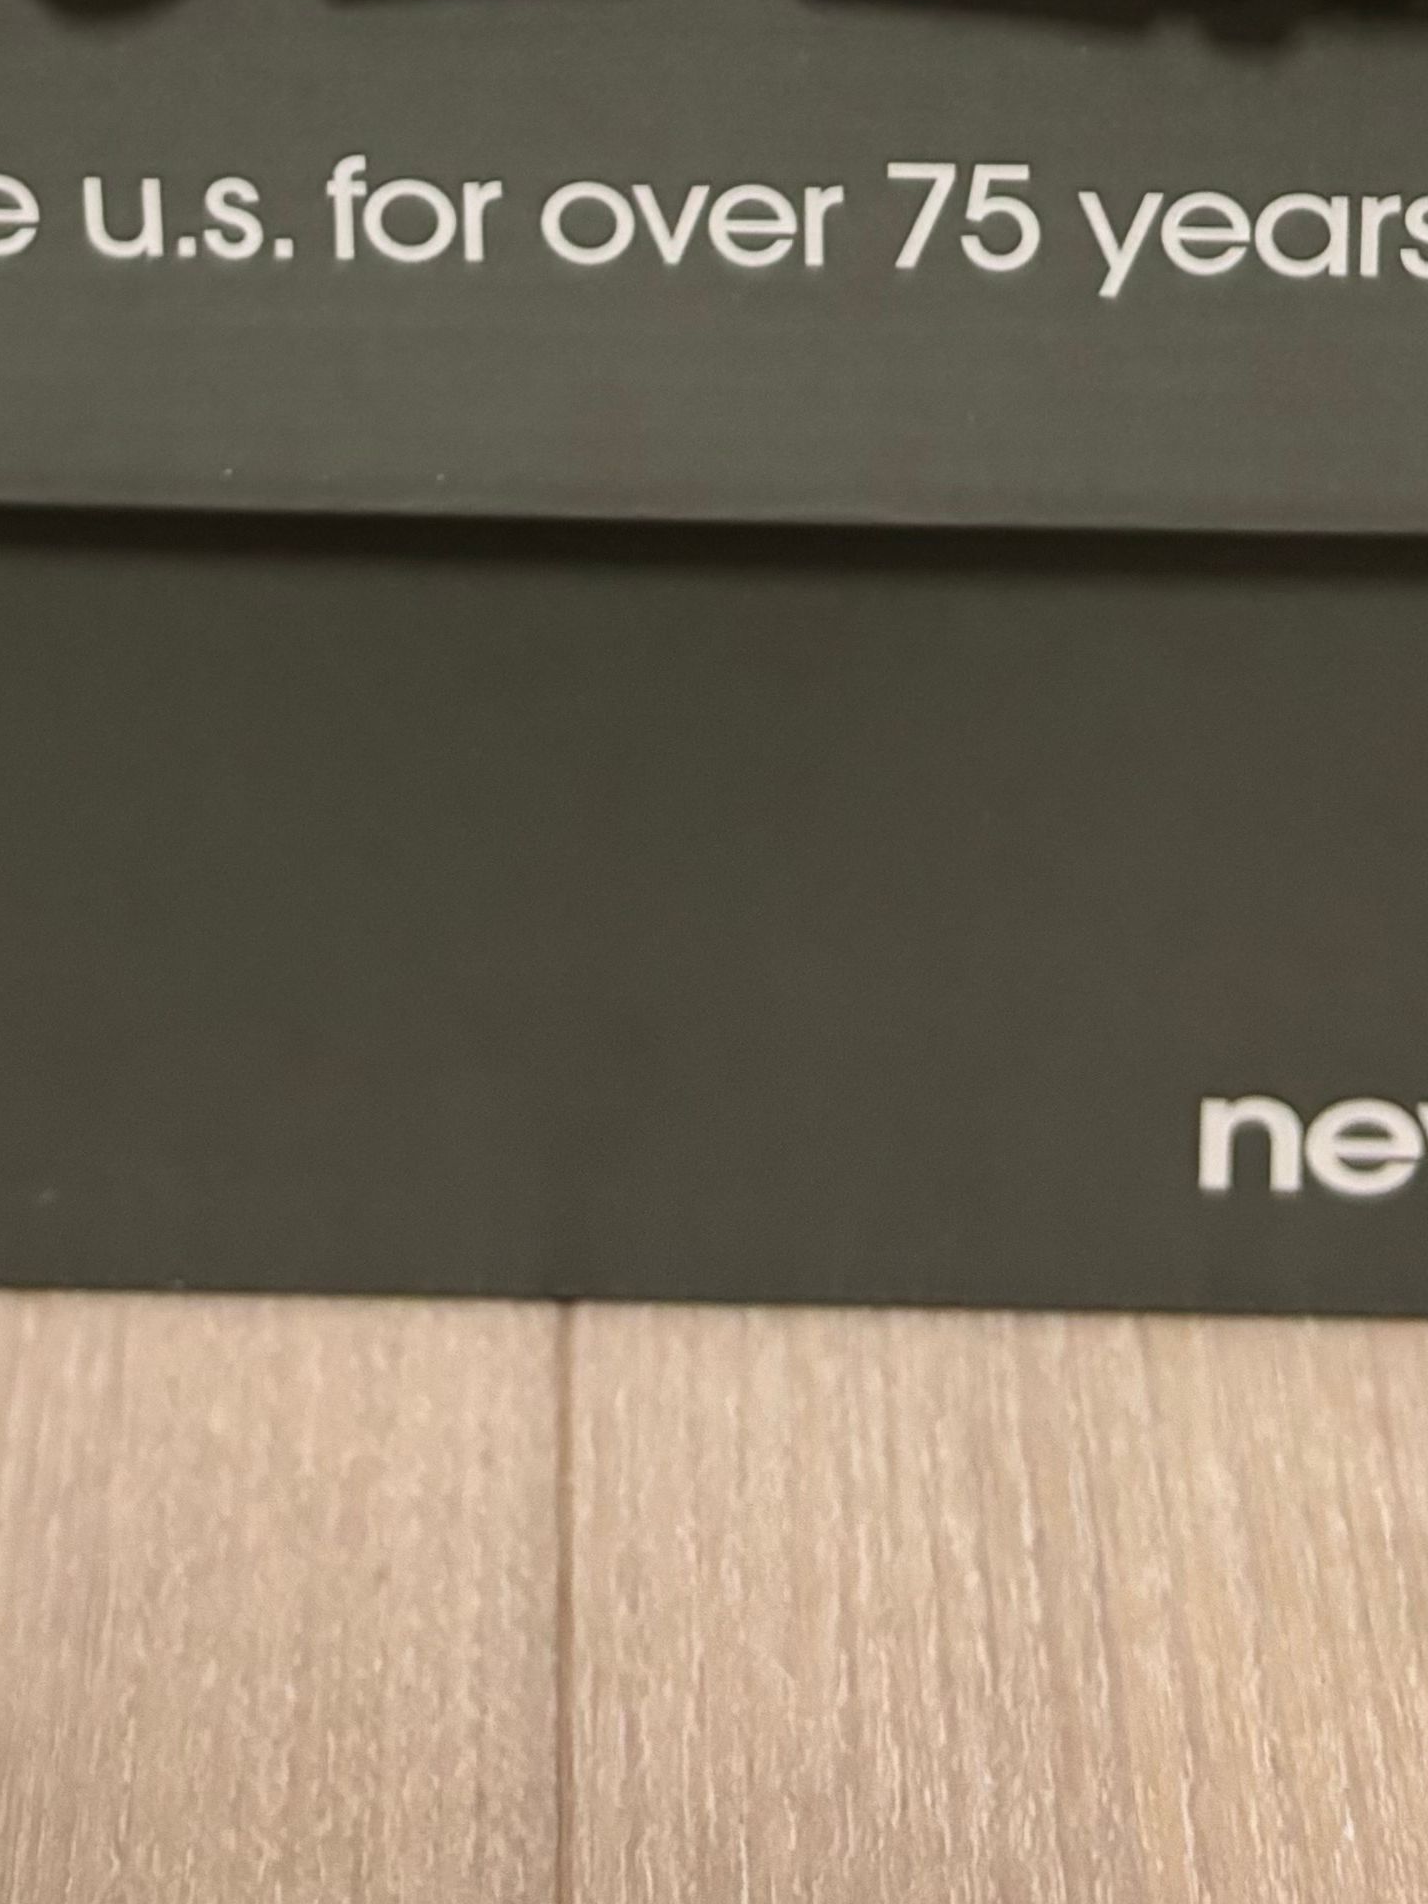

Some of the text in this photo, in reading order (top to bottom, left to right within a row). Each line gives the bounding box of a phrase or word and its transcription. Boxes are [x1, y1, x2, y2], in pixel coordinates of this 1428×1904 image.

[82, 176, 295, 262] u.s.
[325, 154, 503, 264] for
[540, 178, 845, 269] over
[887, 162, 1041, 273] 75
